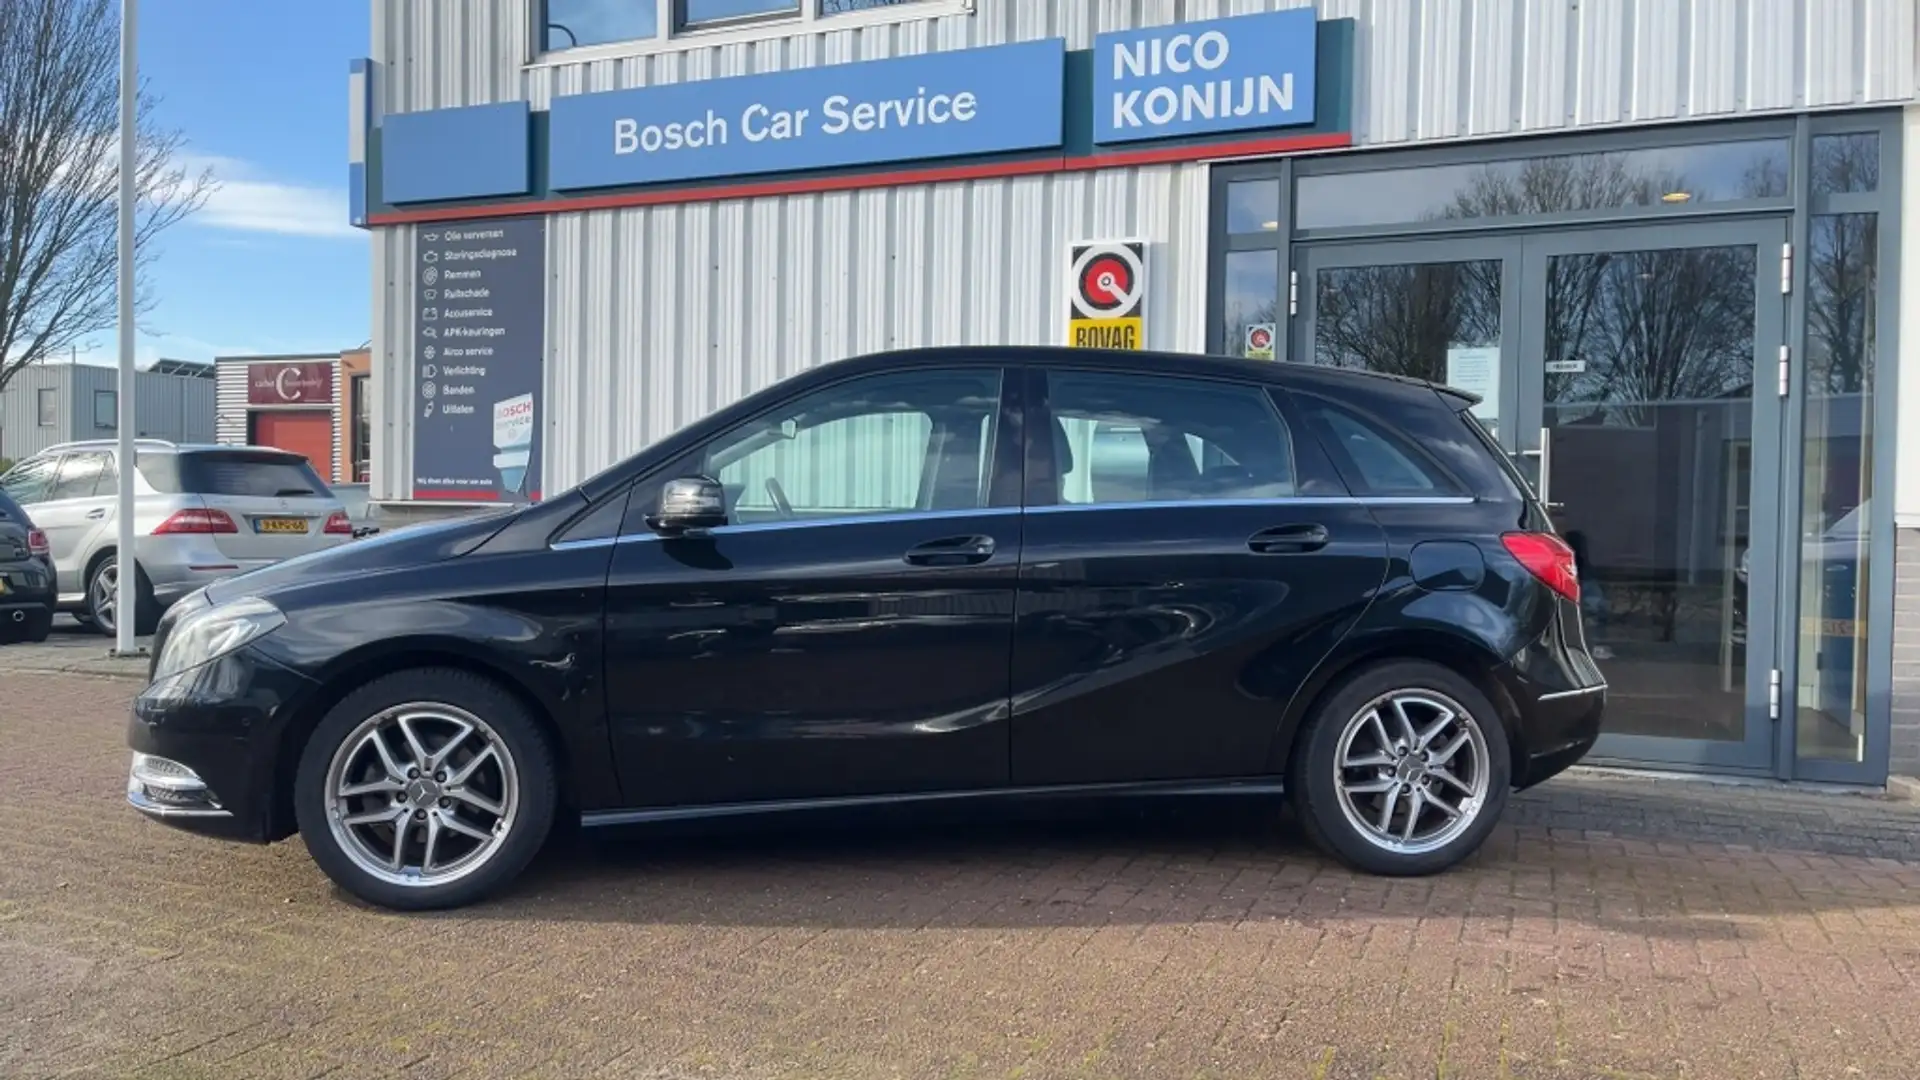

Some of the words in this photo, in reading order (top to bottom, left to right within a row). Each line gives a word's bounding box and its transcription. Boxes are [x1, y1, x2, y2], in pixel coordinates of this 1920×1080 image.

[1113, 30, 1229, 80] NICO
[1113, 73, 1294, 129] KONIJN
[614, 109, 727, 154] Bosch
[742, 103, 809, 142] Car
[821, 86, 977, 134] Service
[444, 270, 481, 279] Remmen
[1076, 325, 1135, 349] BOVAG
[443, 347, 463, 356] Airco
[465, 348, 494, 356] service
[442, 366, 486, 376] Verlichting
[442, 384, 475, 395] Banden
[442, 404, 474, 414] Uitlaten
